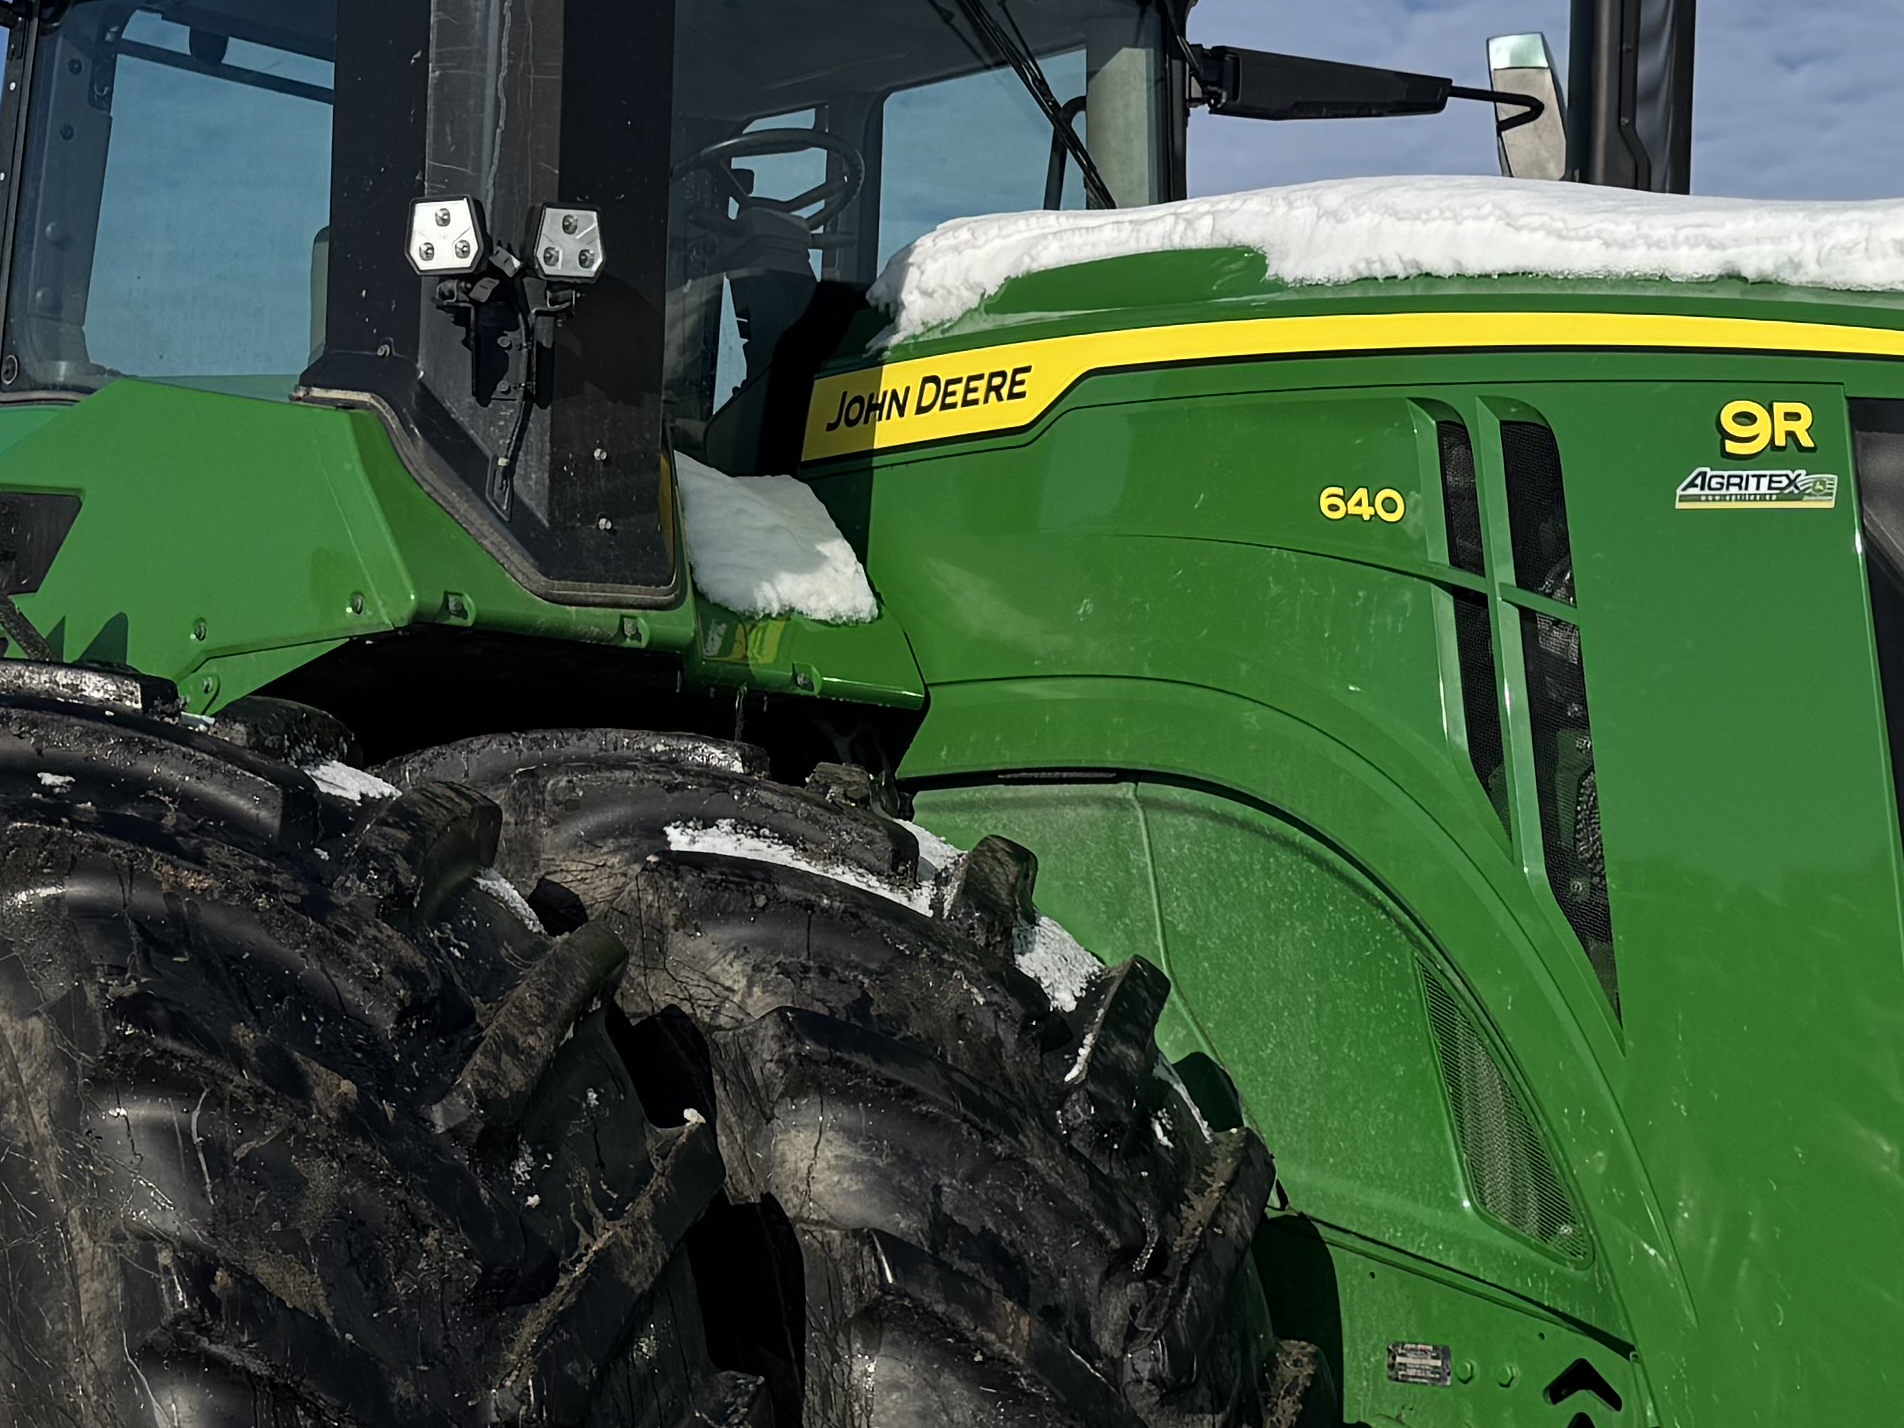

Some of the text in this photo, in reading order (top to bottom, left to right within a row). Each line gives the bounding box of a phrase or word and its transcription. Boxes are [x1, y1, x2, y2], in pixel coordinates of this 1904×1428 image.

[825, 364, 1033, 432] JOHN DEERE
[1718, 399, 1816, 457] 9R
[1319, 486, 1405, 523] 640
[1681, 470, 1802, 492] AGRITEX
